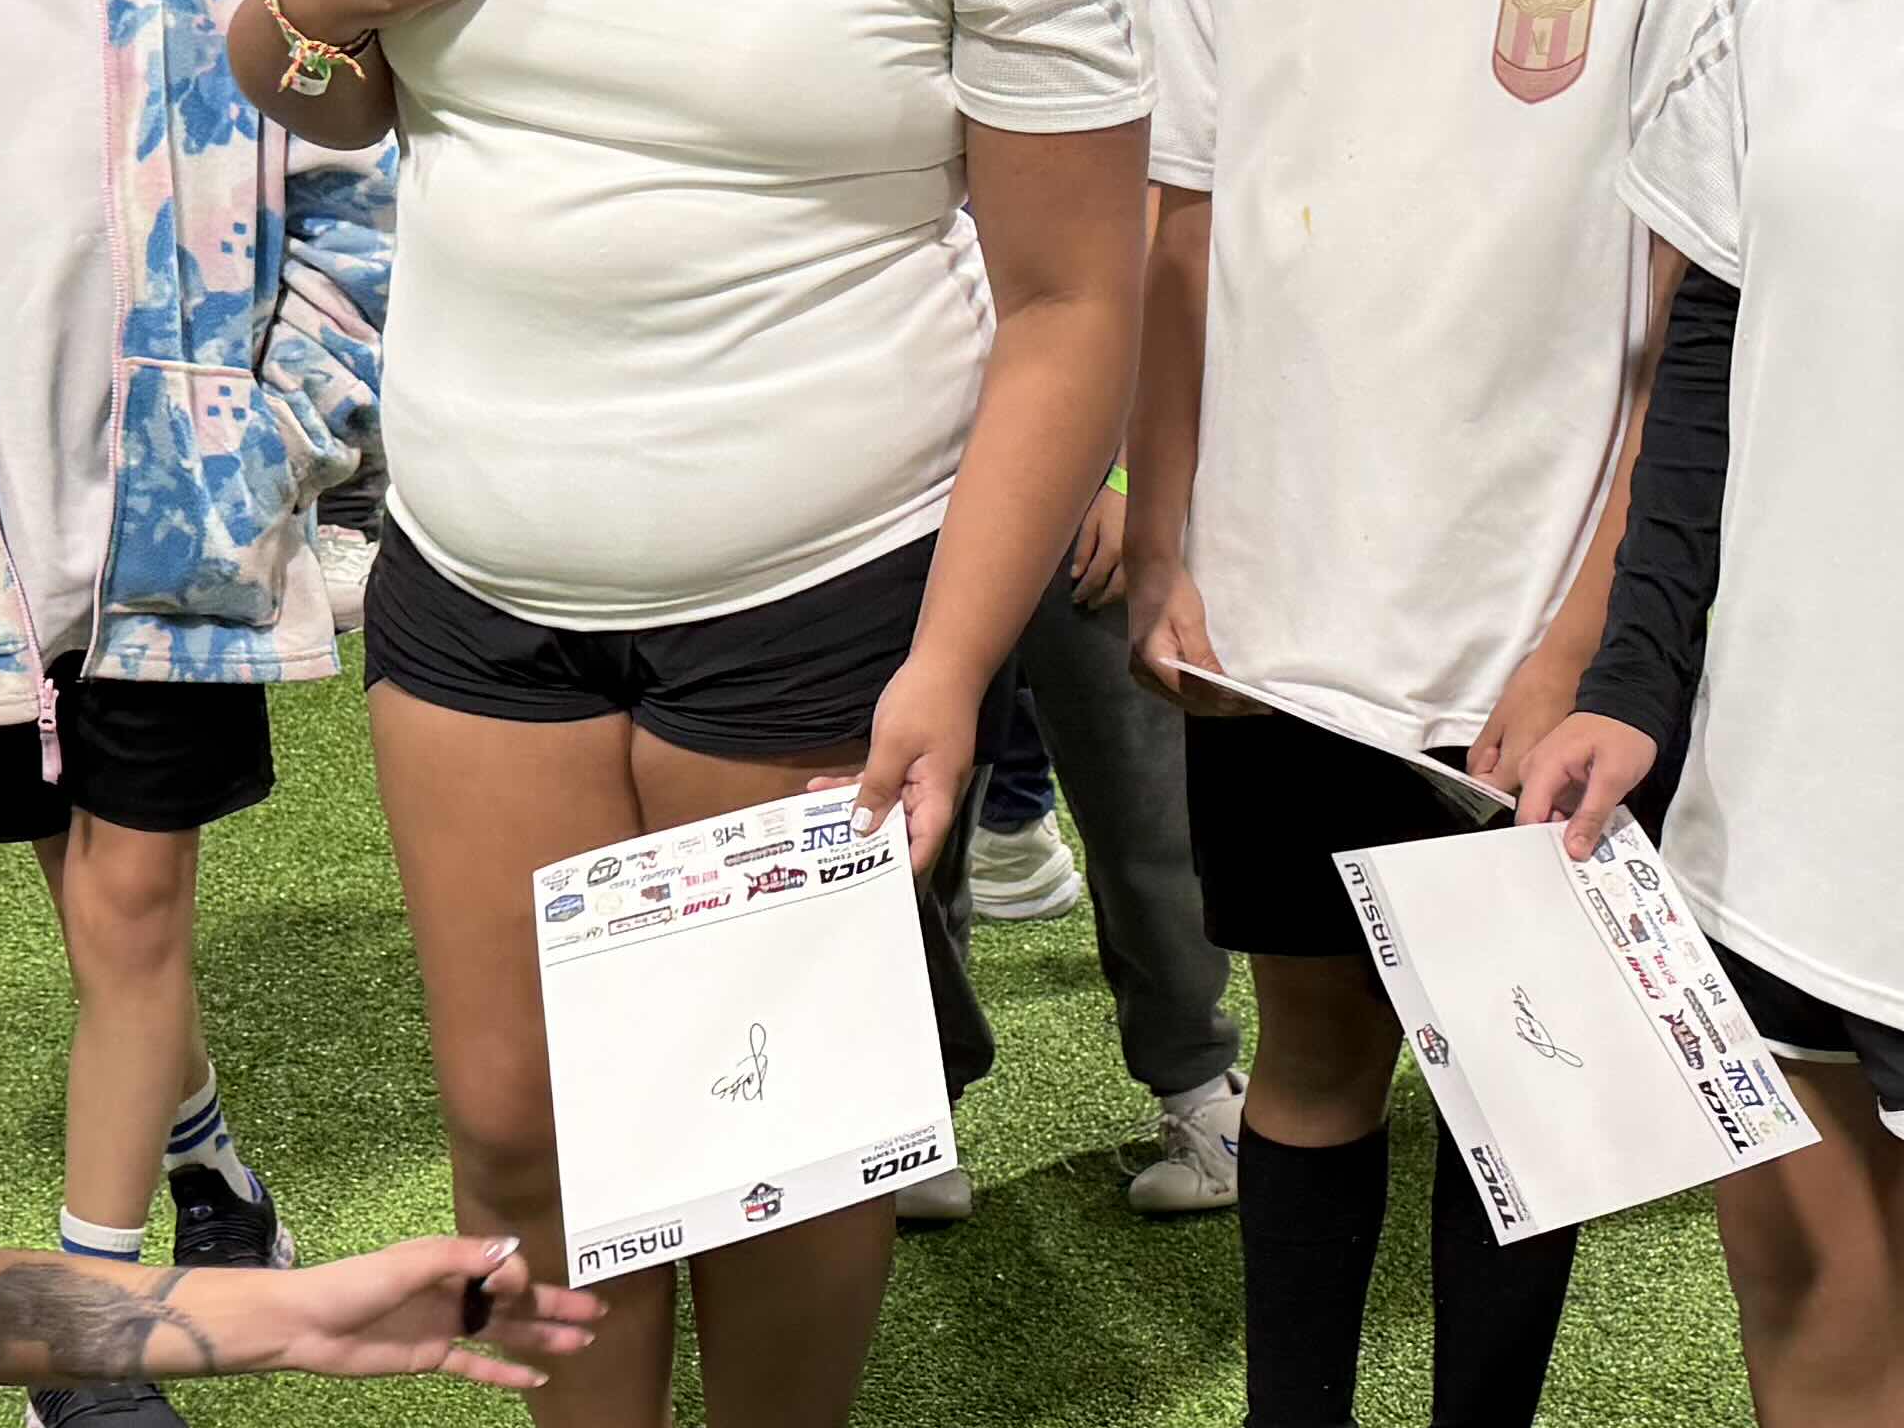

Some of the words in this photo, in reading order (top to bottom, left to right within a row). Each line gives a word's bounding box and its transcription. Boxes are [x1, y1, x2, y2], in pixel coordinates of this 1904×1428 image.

[819, 848, 895, 885] TOCA
[1343, 862, 1398, 967] MASLW
[1698, 1080, 1750, 1155] TOCA
[862, 1144, 943, 1185] TOCA
[1470, 1147, 1516, 1231] TOCA
[578, 1224, 683, 1275] MASLW
